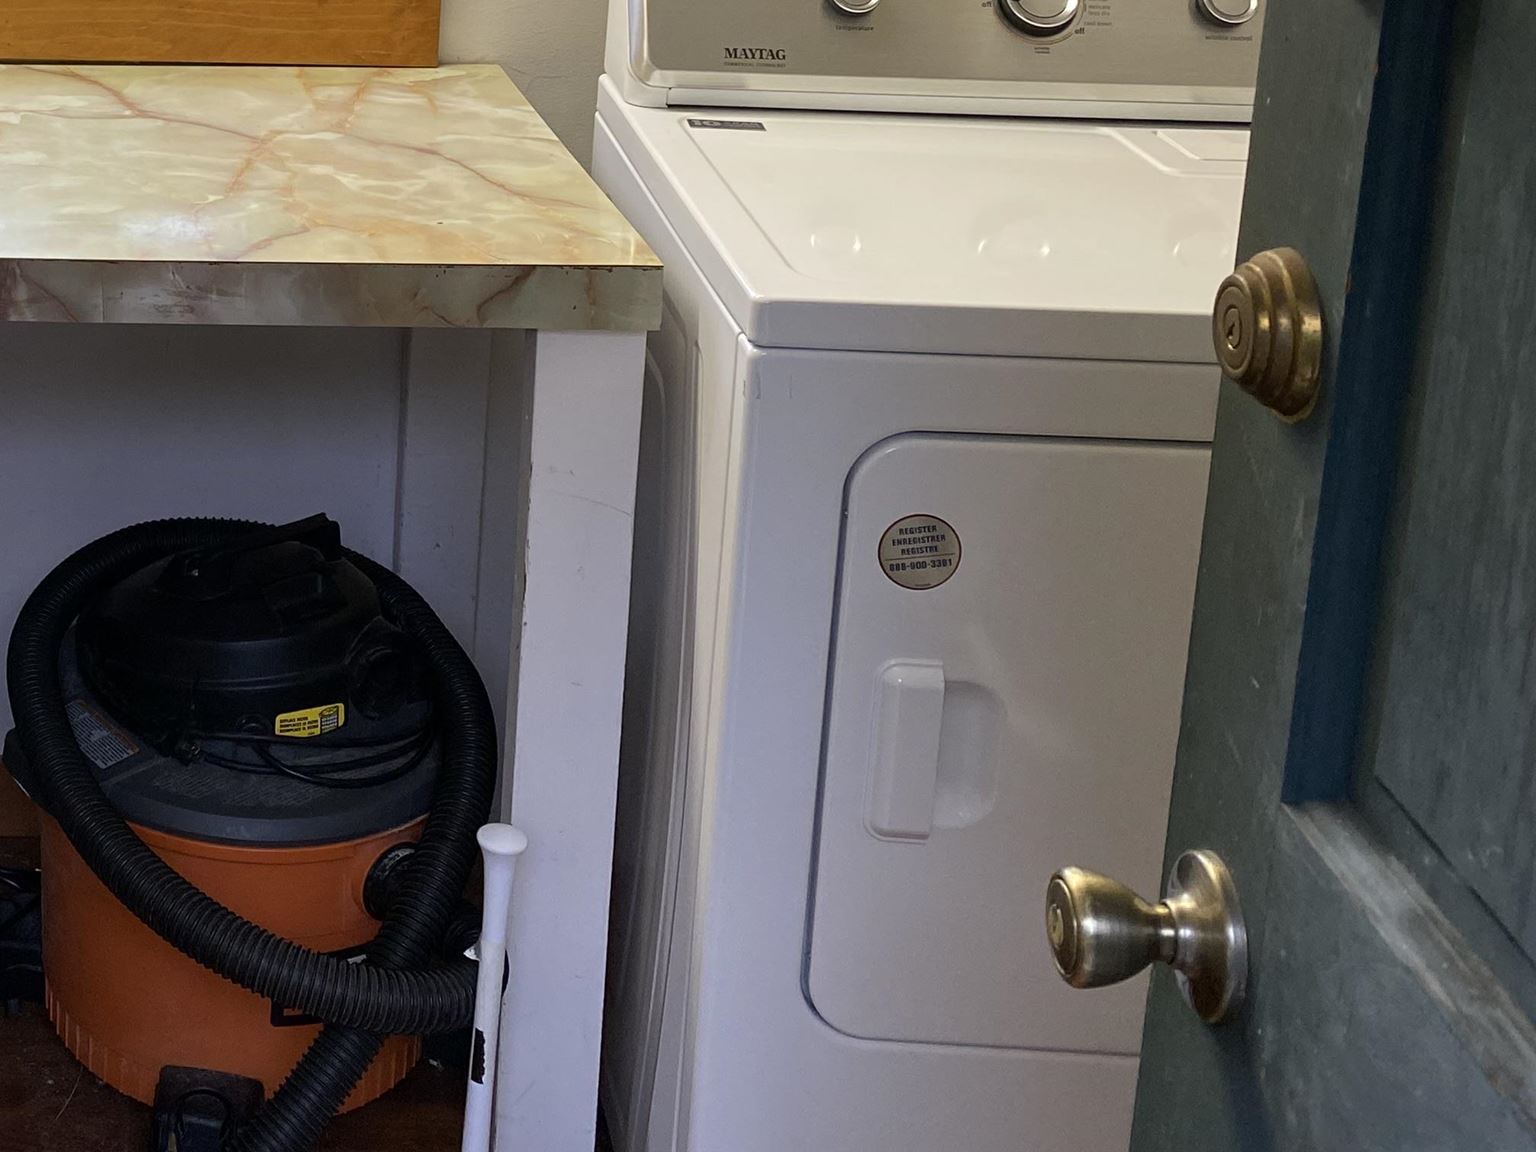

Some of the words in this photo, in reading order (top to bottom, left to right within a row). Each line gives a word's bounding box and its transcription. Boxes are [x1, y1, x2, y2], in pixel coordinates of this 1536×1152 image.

[1074, 27, 1086, 35] off
[723, 47, 787, 61] MAYTAG
[898, 524, 938, 536] REGISTER
[891, 533, 947, 547] ENREGISTRER
